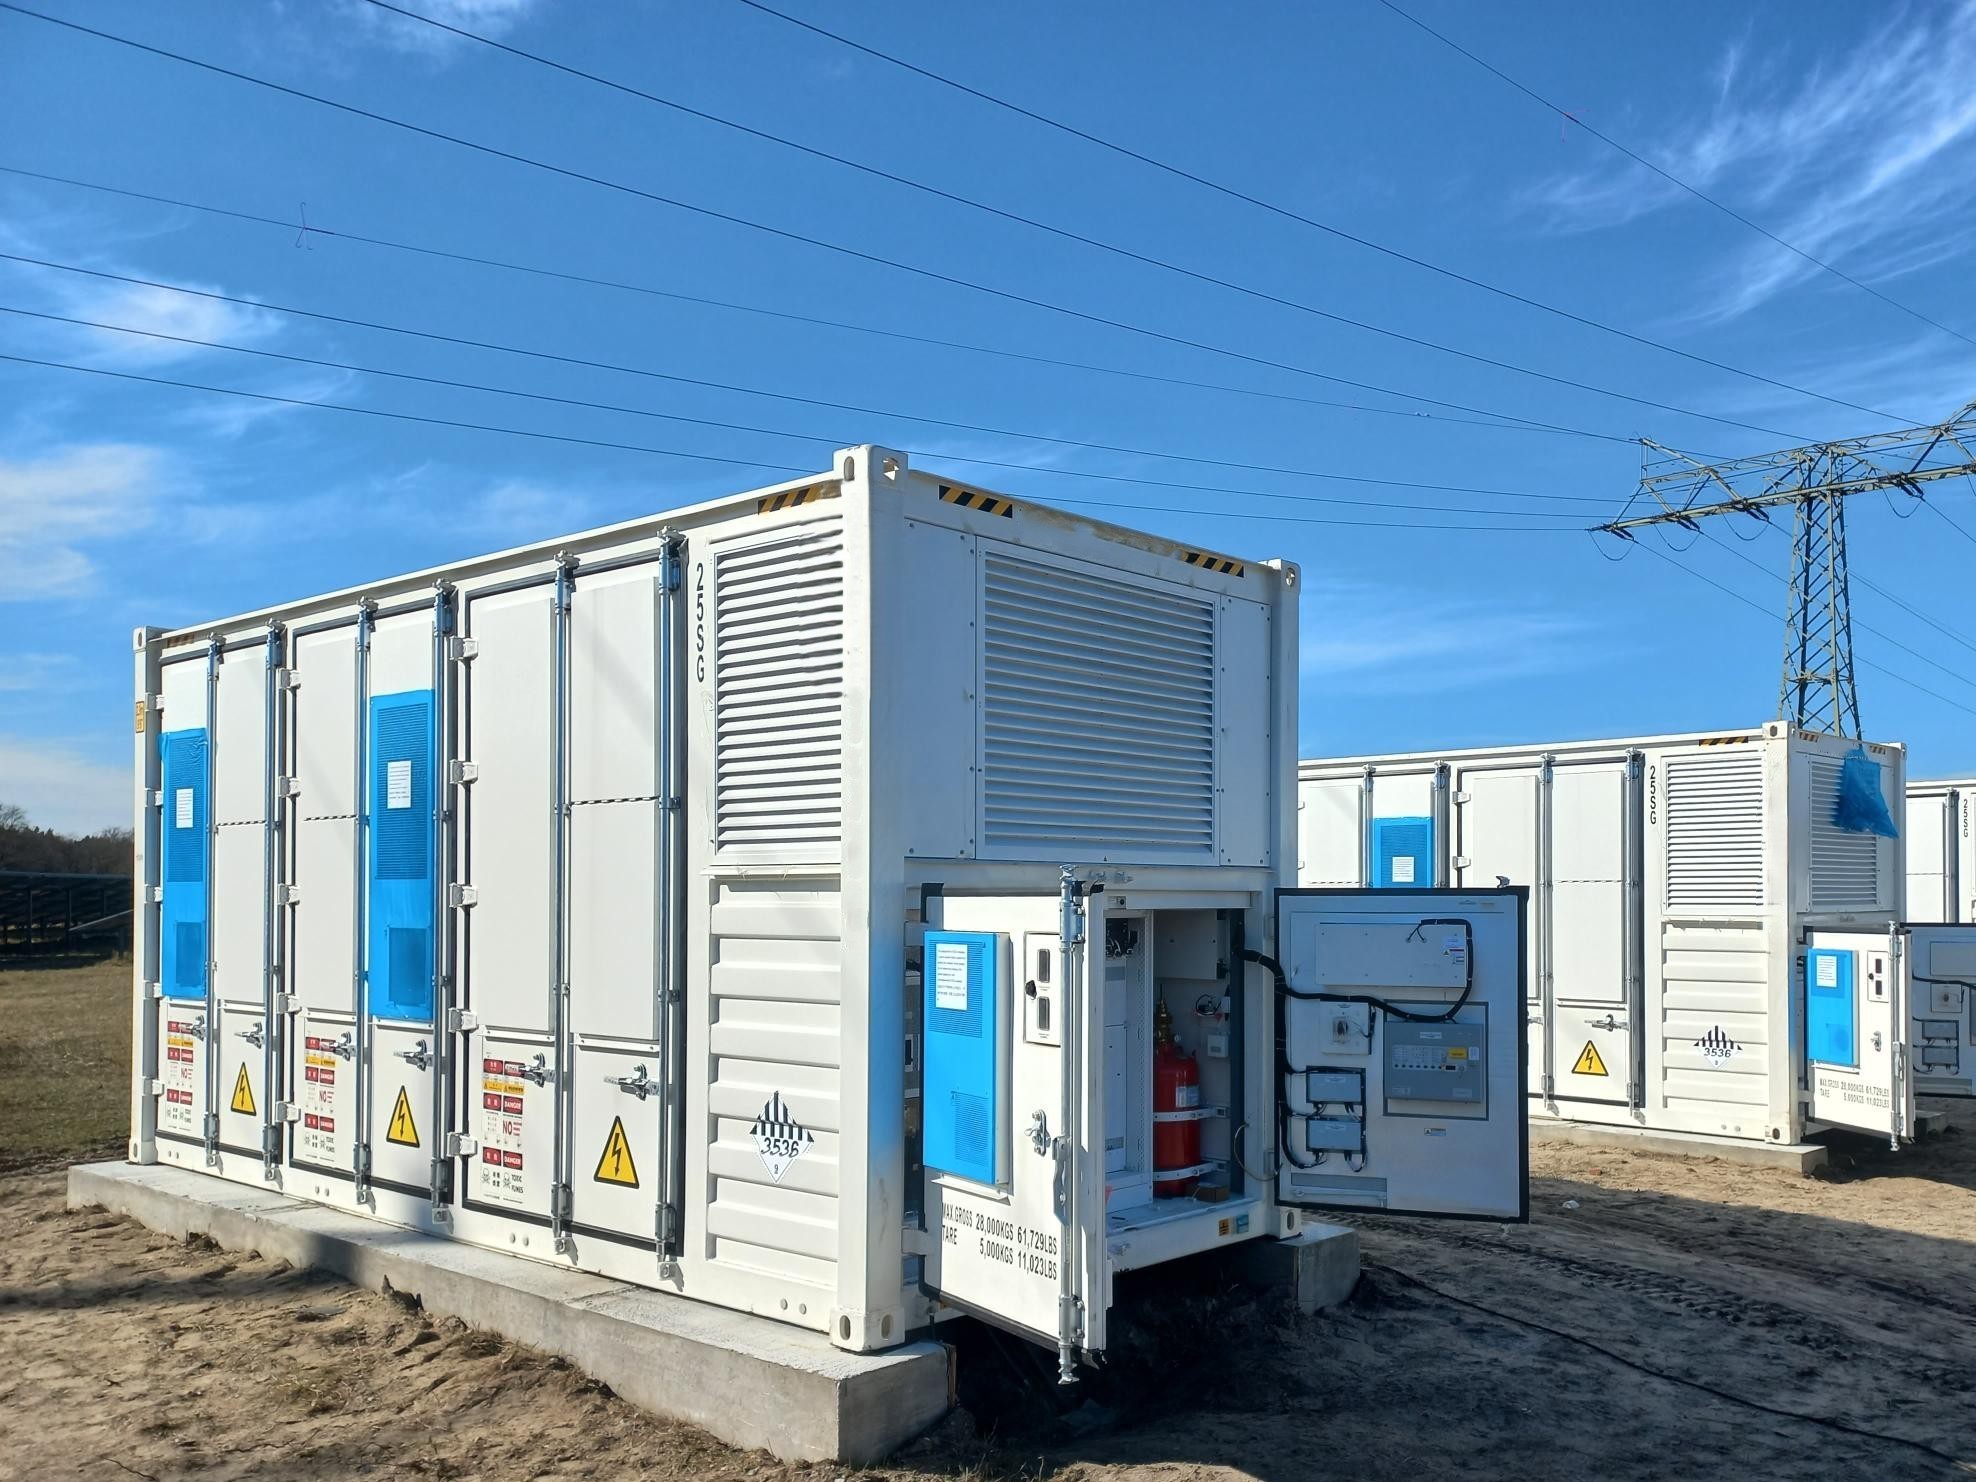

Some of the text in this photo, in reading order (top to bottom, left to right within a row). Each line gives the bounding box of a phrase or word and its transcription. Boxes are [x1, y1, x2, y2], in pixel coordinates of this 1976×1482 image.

[696, 562, 704, 683] 25SG
[1704, 1047, 1732, 1058] 3536
[504, 1101, 522, 1111] DANGER
[502, 1120, 513, 1136] NO
[761, 1137, 800, 1159] 3536
[504, 1155, 522, 1166] DANGER
[774, 1164, 779, 1174] 9
[976, 1213, 1014, 1242] 28,000KGS
[1018, 1226, 1058, 1256] 61,729LBS
[942, 1224, 1058, 1281] TARE 5,000KGS 11,023LBS
